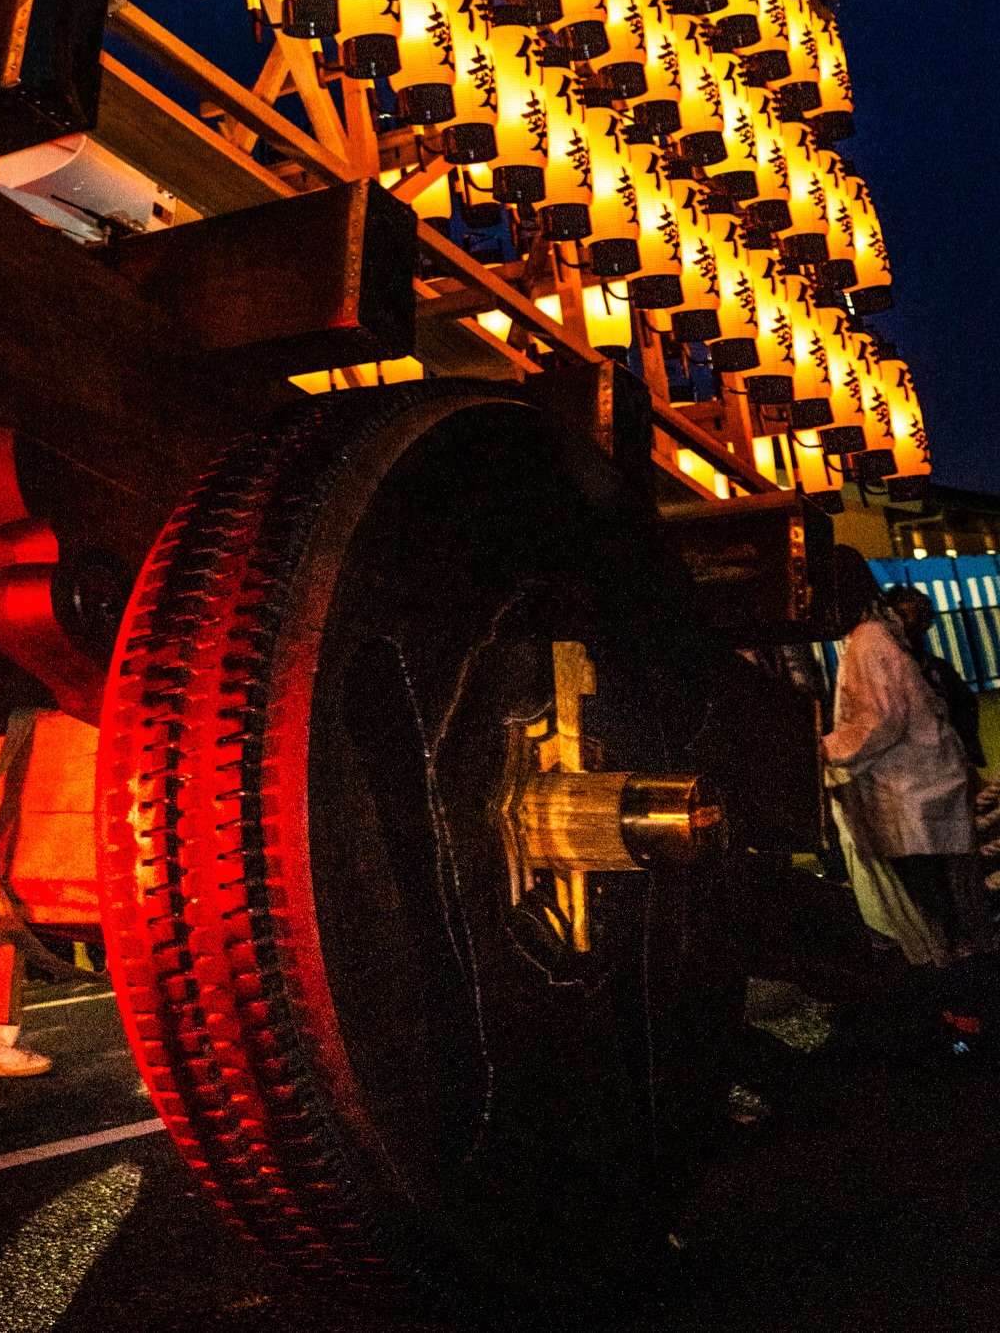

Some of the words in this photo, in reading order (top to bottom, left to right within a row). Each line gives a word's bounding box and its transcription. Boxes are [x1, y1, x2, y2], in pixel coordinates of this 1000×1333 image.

[515, 35, 548, 158] 伊勢
[686, 20, 723, 122] 伊勢
[723, 60, 757, 162] 伊勢
[556, 75, 592, 193] 伊勢
[605, 115, 640, 226] 伊勢
[759, 94, 790, 192] 伊勢
[797, 129, 828, 222] 伊勢
[646, 153, 682, 267] 伊勢
[682, 187, 720, 298] 伊勢
[826, 156, 854, 247] 伊勢
[853, 182, 890, 272] 伊勢
[724, 221, 758, 327] 伊勢
[762, 258, 796, 365] 伊勢
[797, 282, 831, 384] 伊勢
[833, 315, 865, 417] 伊勢
[857, 340, 895, 439] 伊勢
[896, 368, 932, 464] 伊勢
